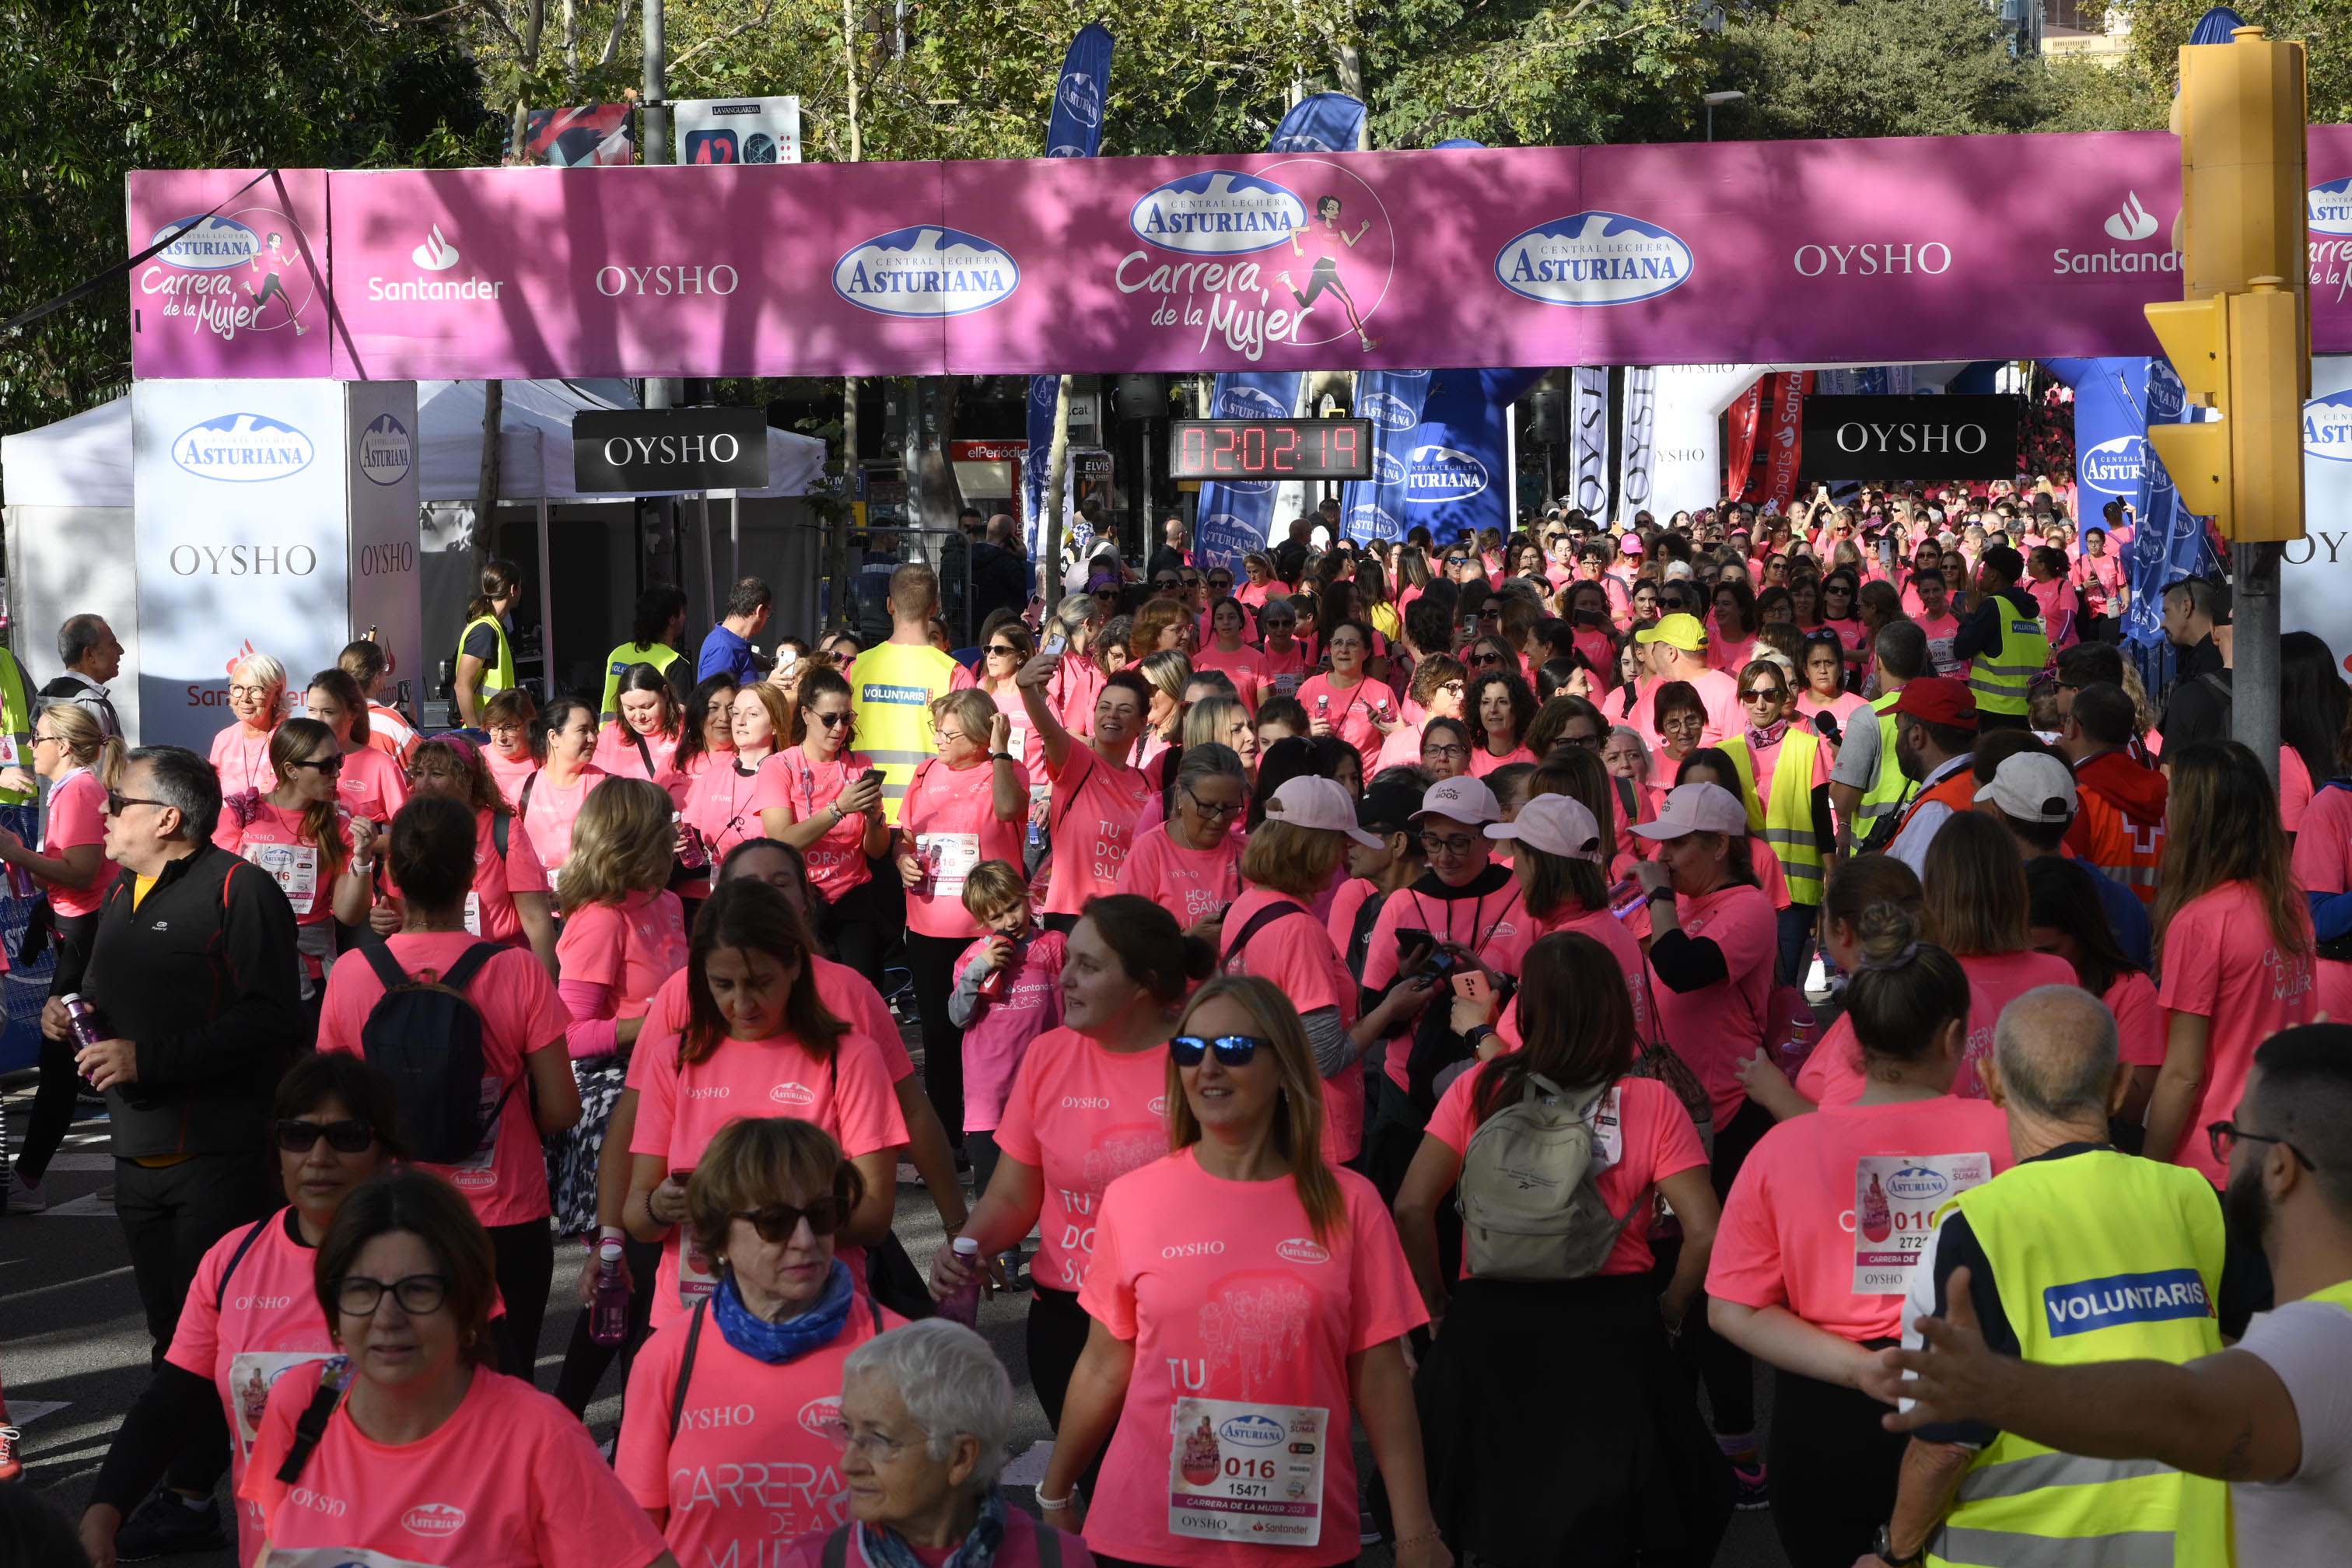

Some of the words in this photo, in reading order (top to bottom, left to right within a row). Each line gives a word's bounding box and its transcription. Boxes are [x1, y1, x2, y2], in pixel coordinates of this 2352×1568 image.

[1171, 199, 1227, 208] CENTRAL
[1232, 198, 1288, 208] LECHERA
[1144, 203, 1293, 233] ASTURIANA
[159, 235, 252, 256] ASTURIANA
[1541, 244, 1602, 255] CENTRAL
[1608, 243, 1671, 253] LECHERA
[876, 257, 934, 267] CENTRAL
[940, 256, 999, 265] LECHERA
[1510, 248, 1678, 282] ASTURIANA
[1794, 242, 1952, 277] OYSHO
[141, 266, 232, 295] Carrera
[596, 264, 739, 296] OYSHO
[847, 260, 1006, 293] ASTURIANA
[1115, 250, 1262, 294] Carrera
[368, 277, 504, 303] Santander
[163, 297, 180, 317] de
[184, 297, 196, 317] la
[194, 292, 267, 341] Mujer
[1151, 296, 1178, 326] de
[1185, 296, 1203, 326] la
[1199, 289, 1316, 362] Mujer
[1780, 370, 1804, 424] Santa
[1577, 366, 1606, 517] OYSH
[1626, 366, 1654, 505] OYSH
[1836, 422, 1987, 454] OYSHO
[183, 439, 304, 465] ASTURIANA
[362, 442, 409, 467] ASTURIANA
[604, 433, 739, 466] OYSHO
[968, 446, 1023, 461] elPeriódi
[1657, 448, 1705, 462] YSHO
[1085, 460, 1109, 471] ELVIS
[2088, 457, 2139, 480] ASTUR
[1409, 473, 1481, 488] TURIANA
[170, 544, 317, 576] OYSHO
[361, 541, 413, 576] OYSHO
[1435, 792, 1459, 800] MOOD
[1099, 820, 1121, 838] TU
[268, 870, 290, 881] 16
[1016, 982, 1055, 993] Santand
[773, 1090, 811, 1102] ASTURIANA
[1062, 1096, 1110, 1110] OYSHO
[1953, 1171, 1980, 1181] SUMA
[1891, 1180, 1943, 1192] ASTURIANA
[1060, 1188, 1090, 1215] TU
[1161, 1241, 1225, 1259] OYSHO
[1899, 1236, 1928, 1248] 272
[1282, 1246, 1326, 1259] ASTURIANA
[1869, 1255, 1902, 1264] CARRERA
[1864, 1274, 1902, 1285] OYSHO
[235, 1295, 290, 1311] OYSHO
[2048, 1283, 2206, 1323] VOLUNTARIS
[1166, 1358, 1206, 1391] TU
[1224, 1426, 1281, 1440] ASTURIANA
[1289, 1424, 1315, 1433] SUMA
[1224, 1458, 1276, 1479] 016
[671, 1462, 841, 1512] CARRERA
[1228, 1483, 1267, 1497] 15471
[1187, 1497, 1228, 1508] CARRERA
[1230, 1502, 1242, 1510] DE
[1244, 1503, 1255, 1511] LA
[1258, 1503, 1285, 1513] MUJER
[1287, 1505, 1306, 1514] 2023
[1181, 1515, 1227, 1530] OYSHO
[1265, 1524, 1307, 1535] Santander
